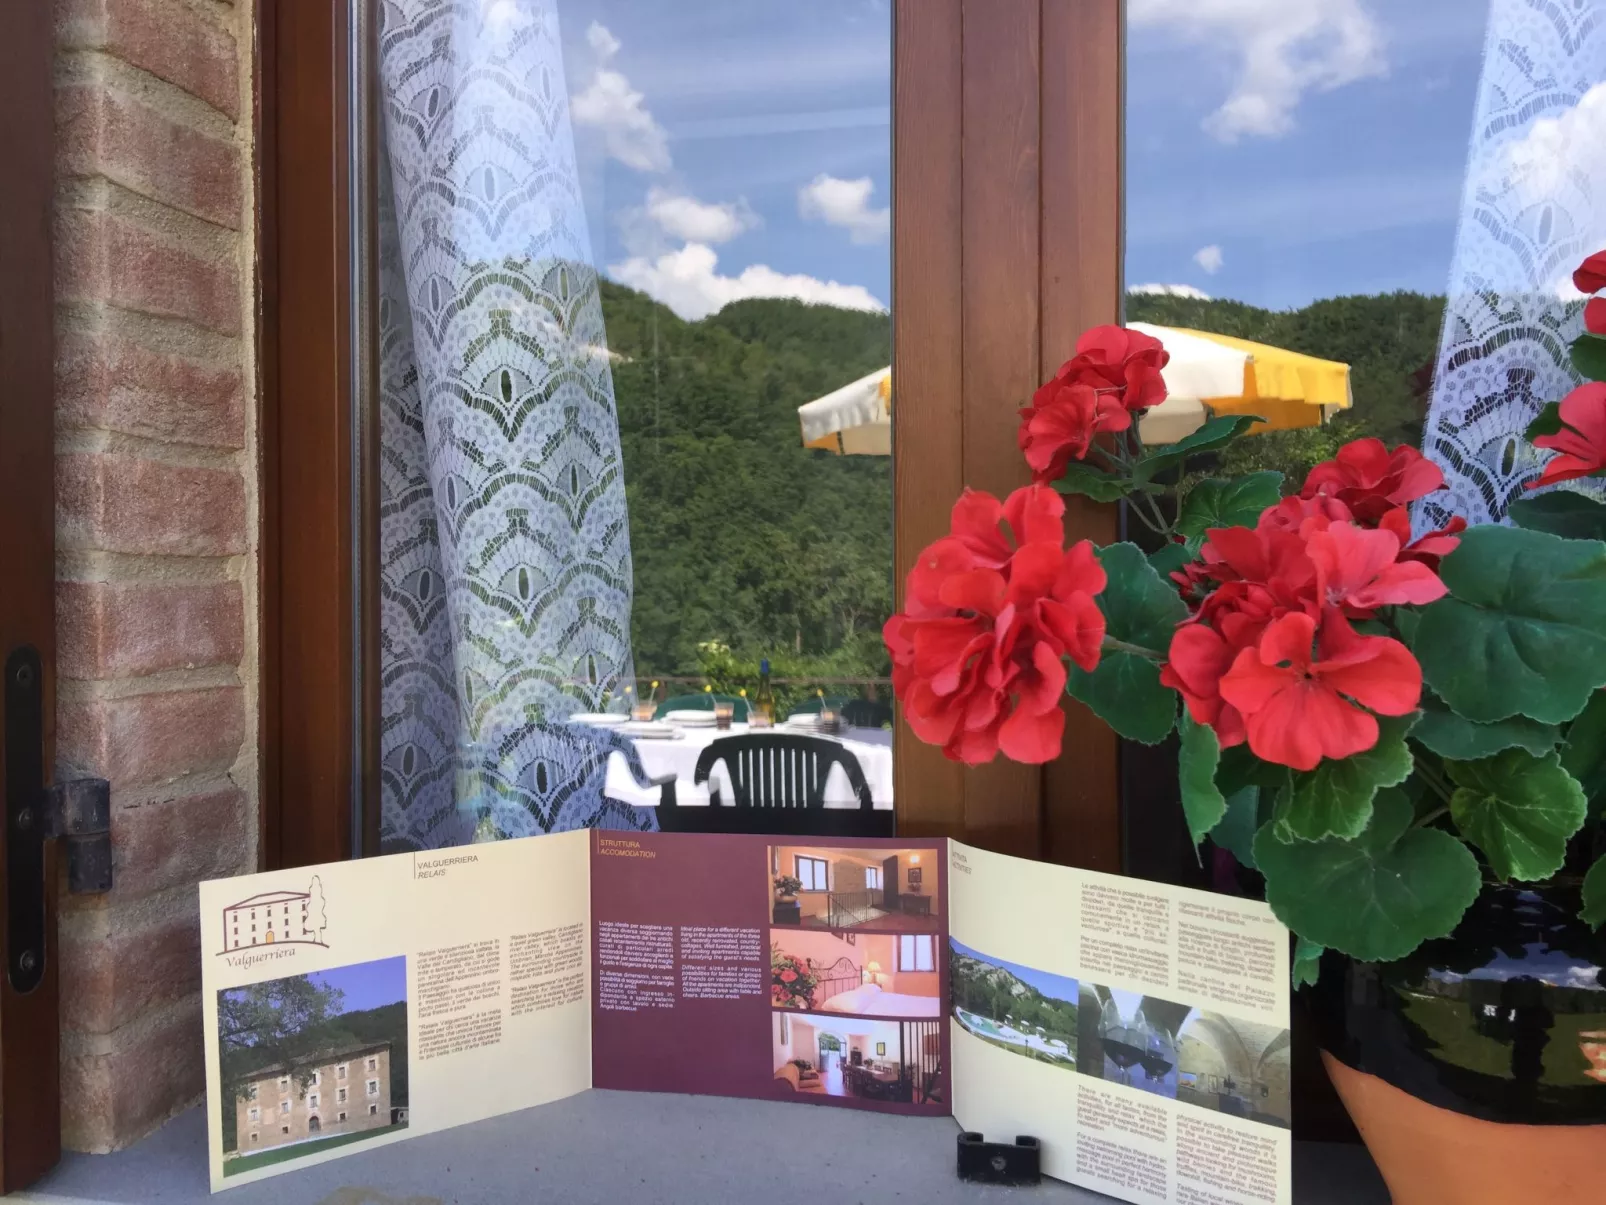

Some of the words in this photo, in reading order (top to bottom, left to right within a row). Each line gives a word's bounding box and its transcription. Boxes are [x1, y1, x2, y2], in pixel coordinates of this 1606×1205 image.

[600, 839, 640, 848] STRUTTURA
[600, 848, 656, 858] ACCOMODATION
[417, 855, 478, 869] VALGUERRIERA
[418, 869, 446, 879] RELAIS
[226, 947, 296, 969] Valguerriera
